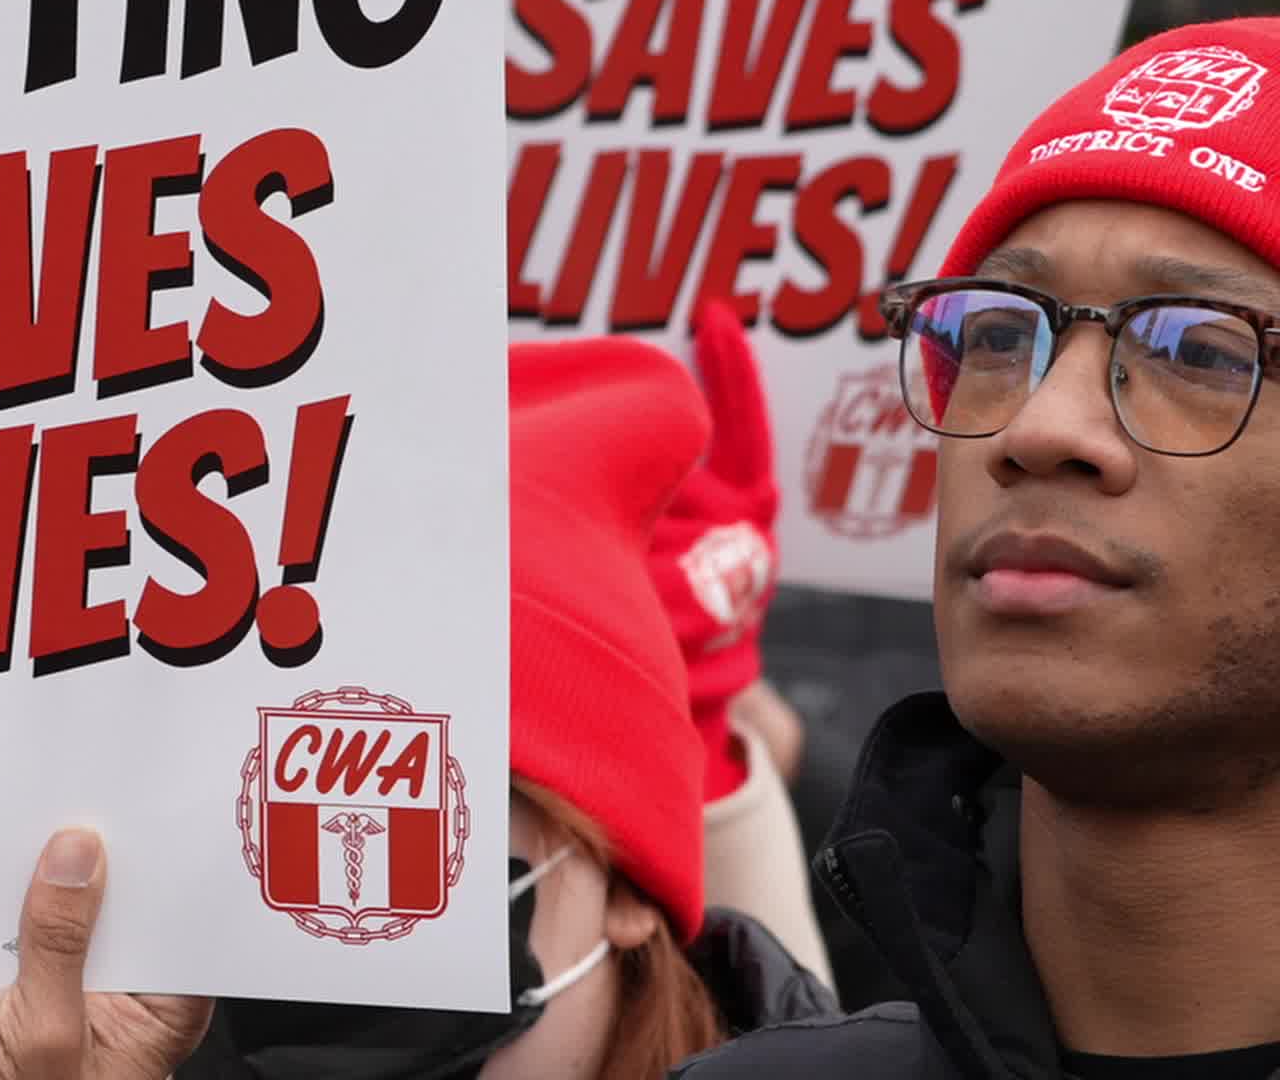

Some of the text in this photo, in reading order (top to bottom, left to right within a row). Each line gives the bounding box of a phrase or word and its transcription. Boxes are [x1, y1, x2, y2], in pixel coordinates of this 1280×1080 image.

[1146, 55, 1252, 87] CWA
[1028, 129, 1268, 193] DISTRICT ONE
[507, 139, 959, 341] LIVES!
[274, 723, 430, 800] CWA
